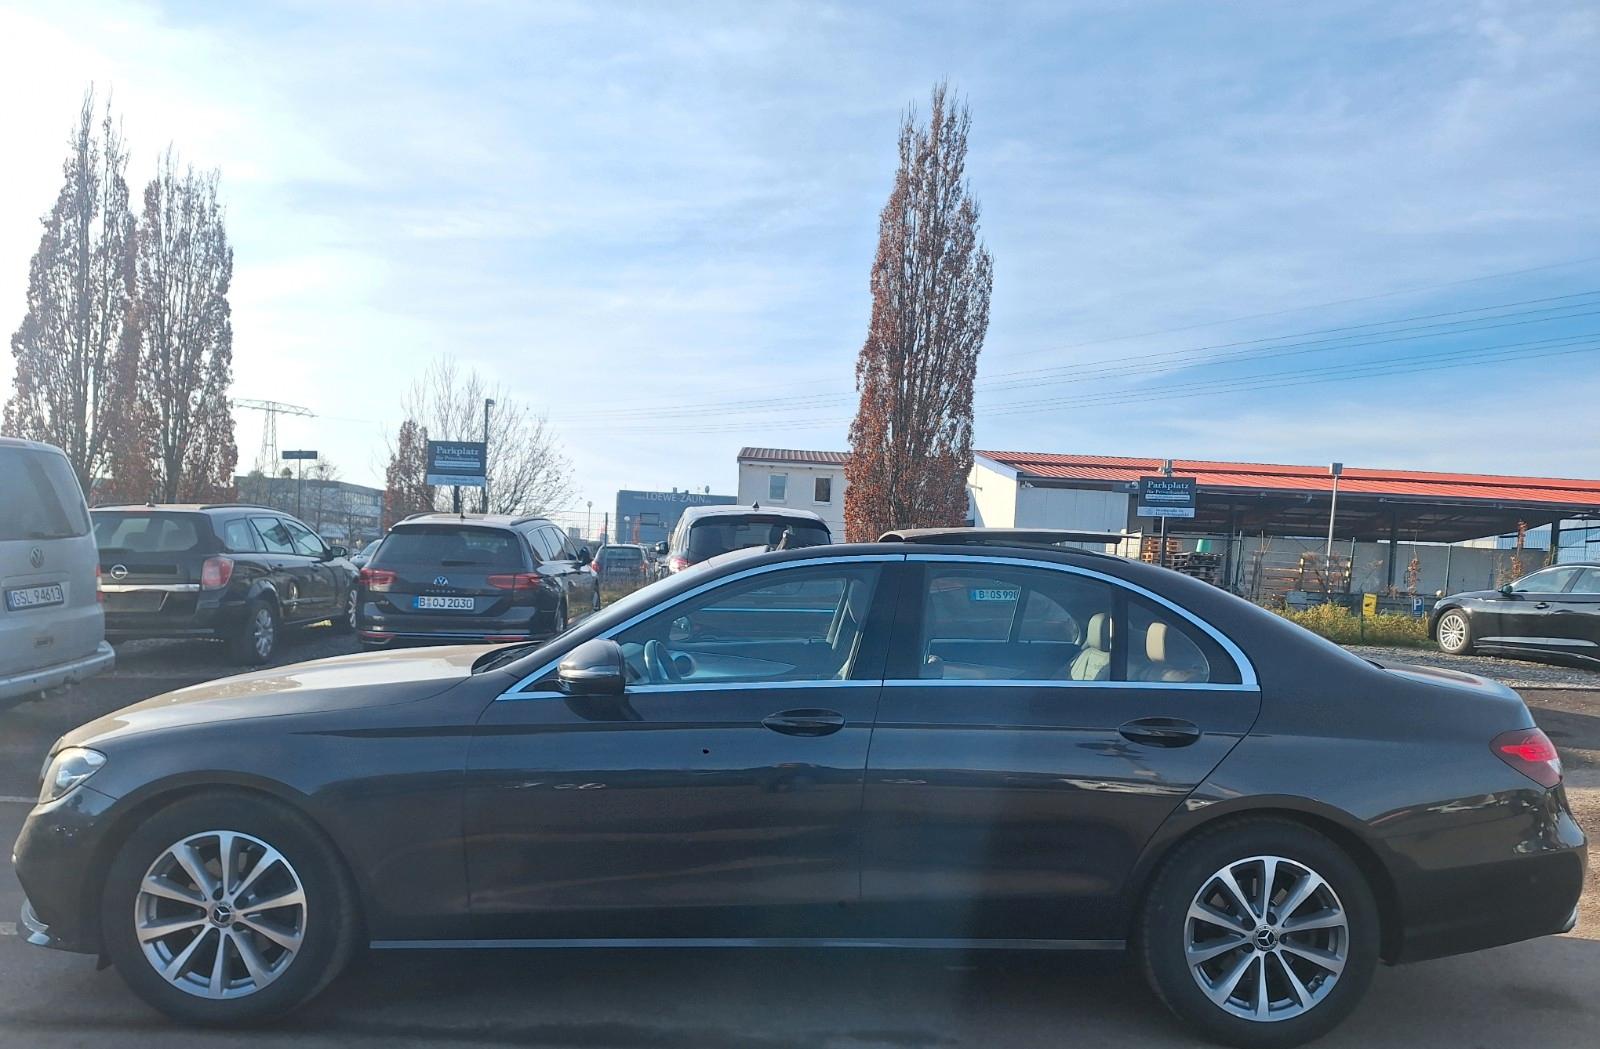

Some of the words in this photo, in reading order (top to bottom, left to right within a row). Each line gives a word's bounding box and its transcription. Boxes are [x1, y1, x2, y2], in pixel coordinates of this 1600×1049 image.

[436, 445, 479, 456] Parkplatz
[1147, 480, 1189, 490] Parkplatz
[33, 586, 61, 602] 94613
